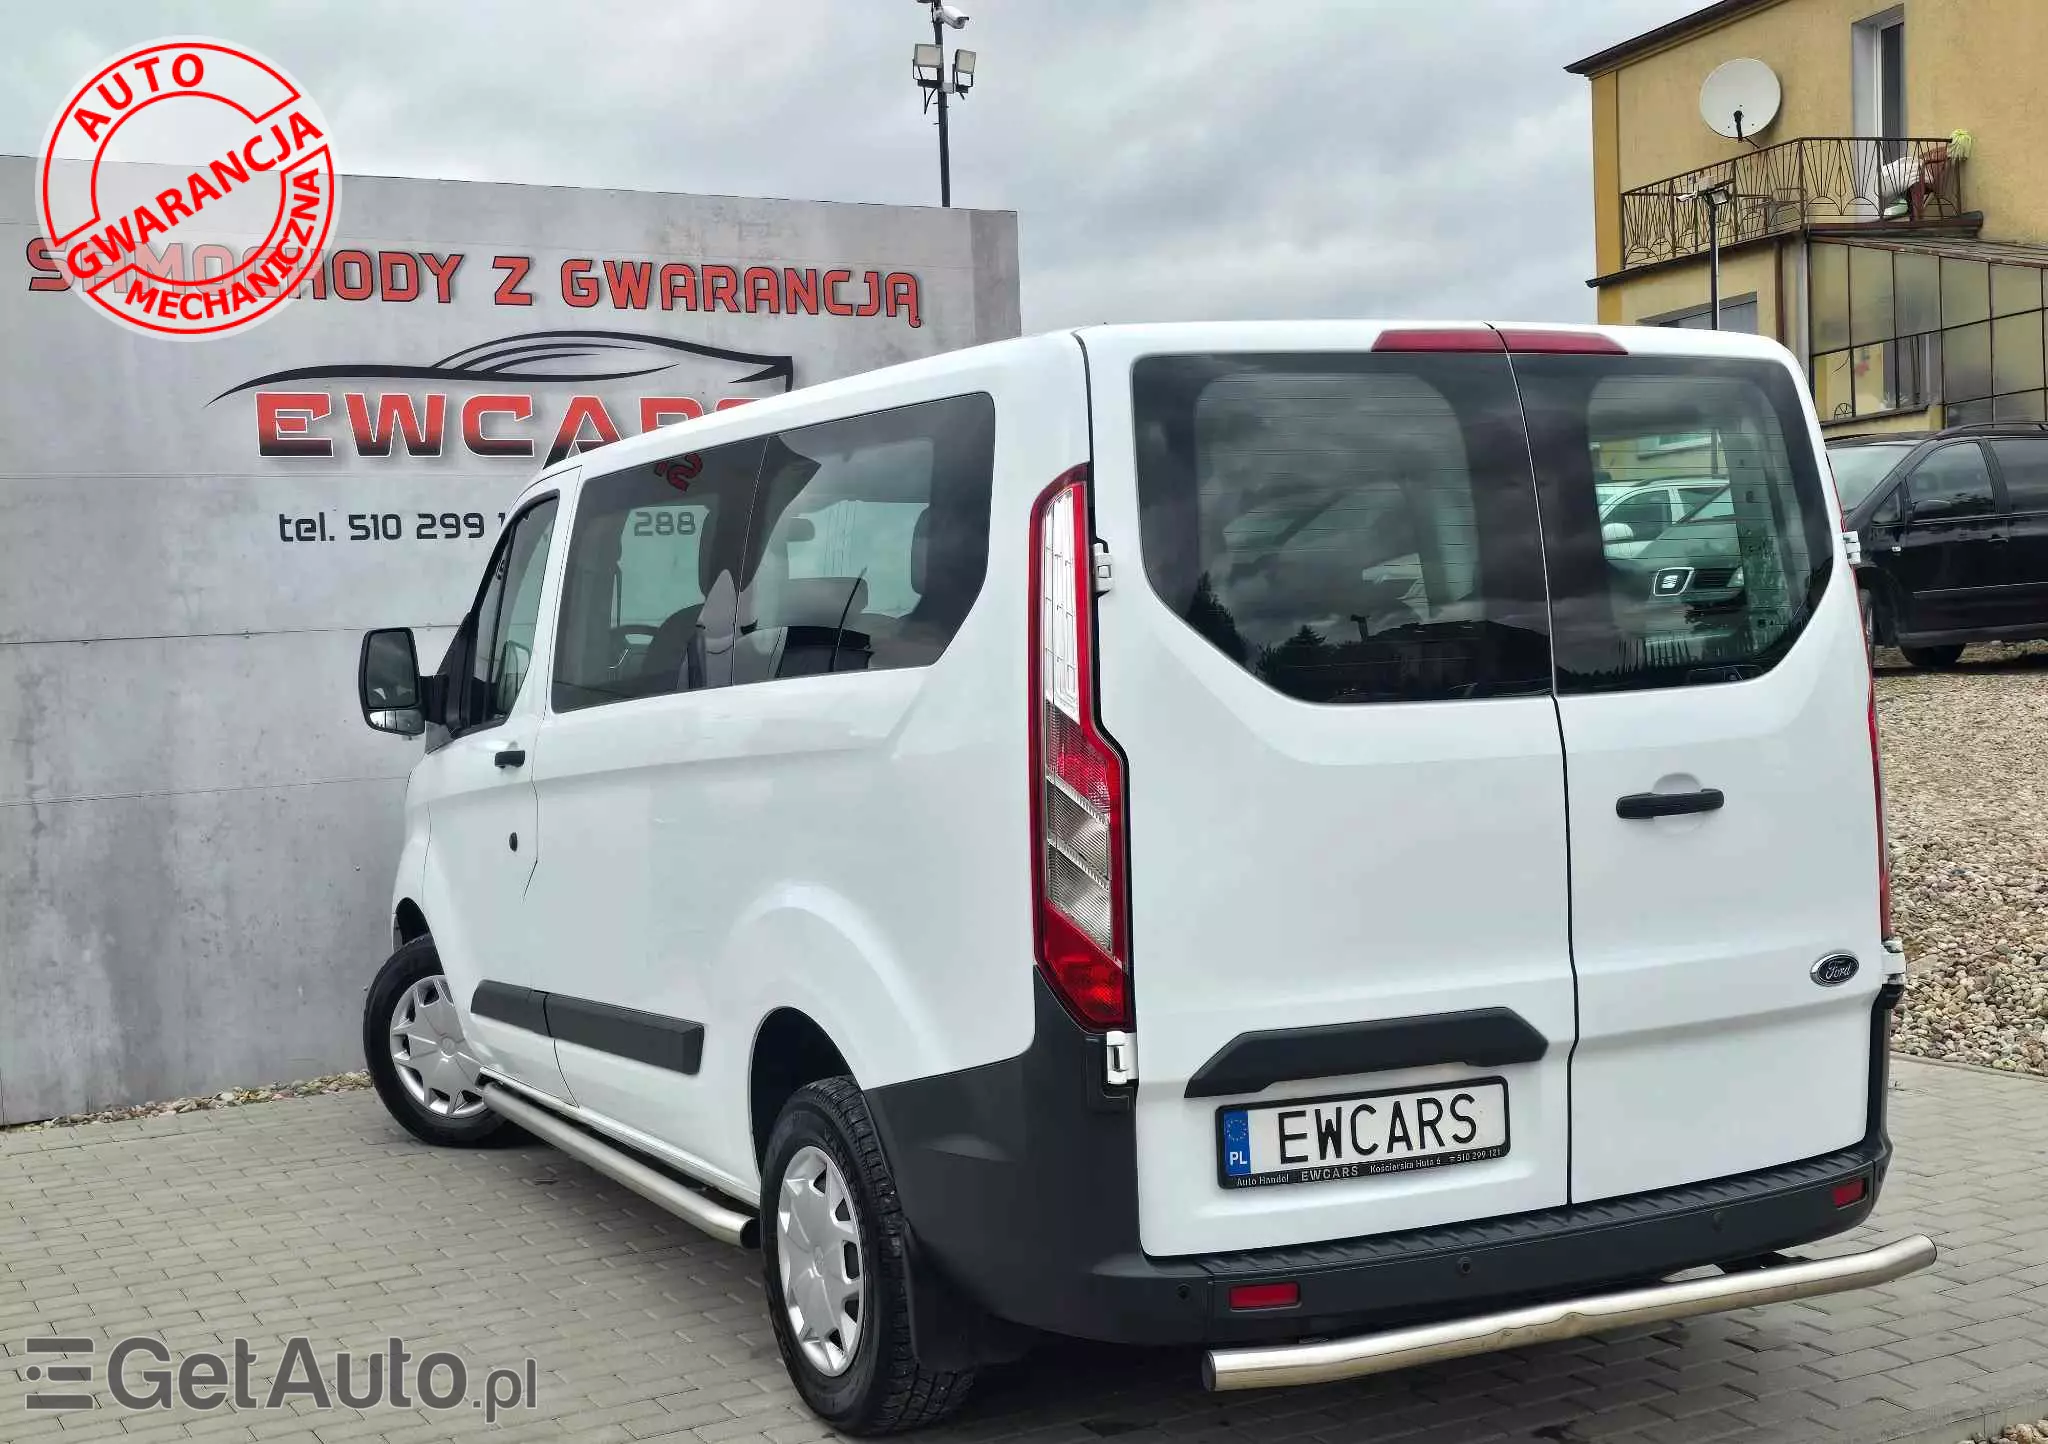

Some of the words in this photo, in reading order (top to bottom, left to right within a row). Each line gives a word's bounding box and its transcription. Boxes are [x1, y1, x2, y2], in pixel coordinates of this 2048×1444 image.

[492, 256, 532, 305] Z
[561, 258, 921, 328] GWARANCJĄ
[256, 392, 762, 469] EWCA
[279, 512, 335, 542] tel.
[348, 514, 402, 541] 510
[416, 513, 485, 540] 299
[634, 511, 696, 536] 288
[1825, 961, 1851, 980] Ford
[1278, 1093, 1477, 1164] EWCARS
[1229, 1151, 1248, 1166] PL
[1237, 1178, 1257, 1187] Auto
[1259, 1173, 1289, 1185] Handel
[1301, 1165, 1359, 1181] EWCARS
